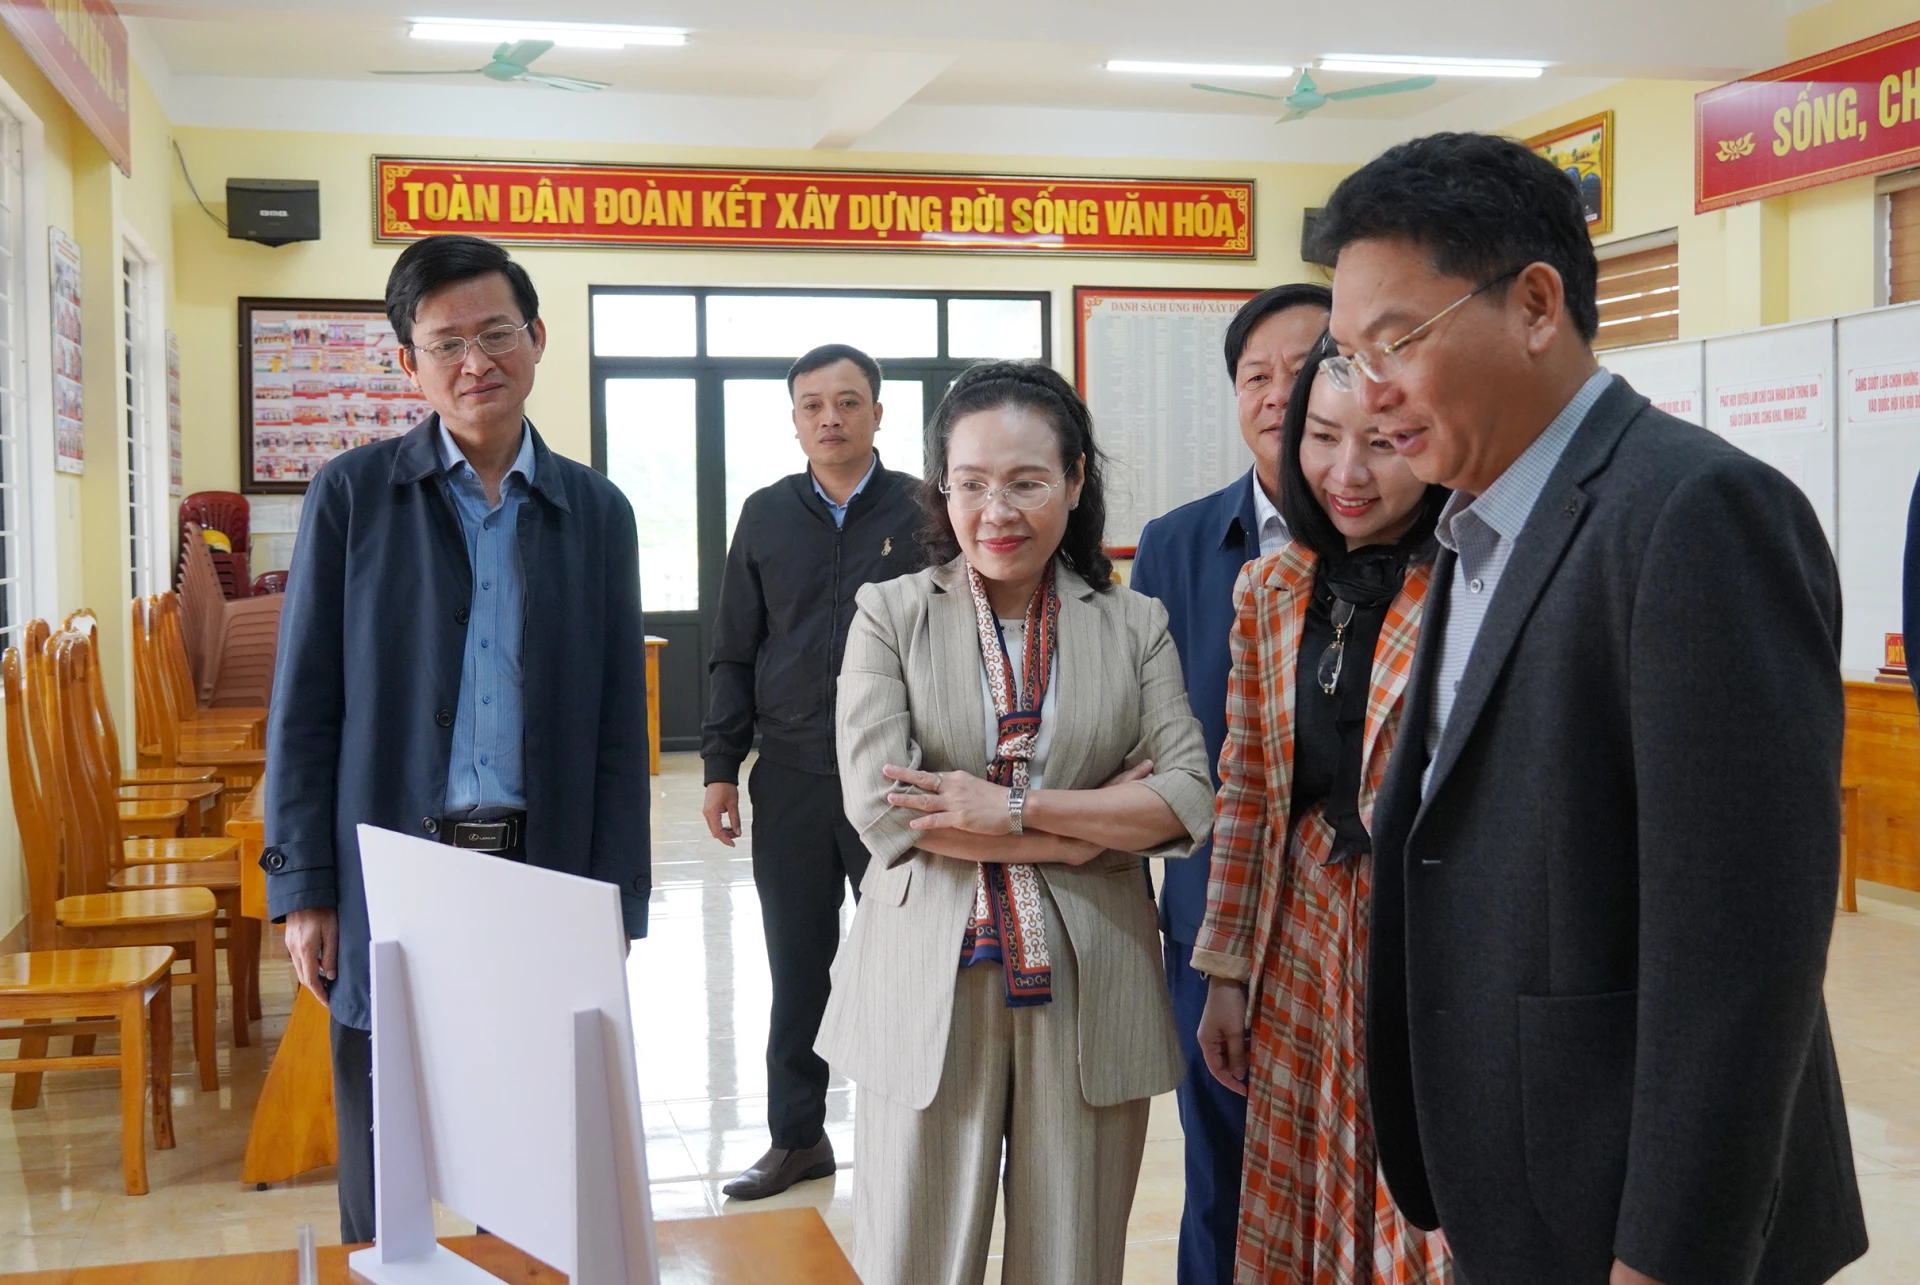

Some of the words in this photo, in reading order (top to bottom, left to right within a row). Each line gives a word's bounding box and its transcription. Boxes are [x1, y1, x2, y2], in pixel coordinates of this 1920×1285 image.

[1772, 81, 1867, 157] SỐNG,
[403, 174, 499, 223] TOÀN
[510, 179, 585, 225] DÂN
[594, 179, 693, 227] ĐOÀN
[702, 178, 767, 229] KẾT
[776, 185, 840, 230] XÂY
[848, 190, 943, 238] DỰNG
[950, 188, 1005, 234] ĐỜI
[1011, 186, 1099, 236] SỐNG
[1104, 192, 1167, 237] VĂN
[1173, 194, 1236, 238] HÓA
[1111, 302, 1138, 312] DANH
[1140, 300, 1167, 312] SÁCH
[1208, 300, 1226, 313] XÂY
